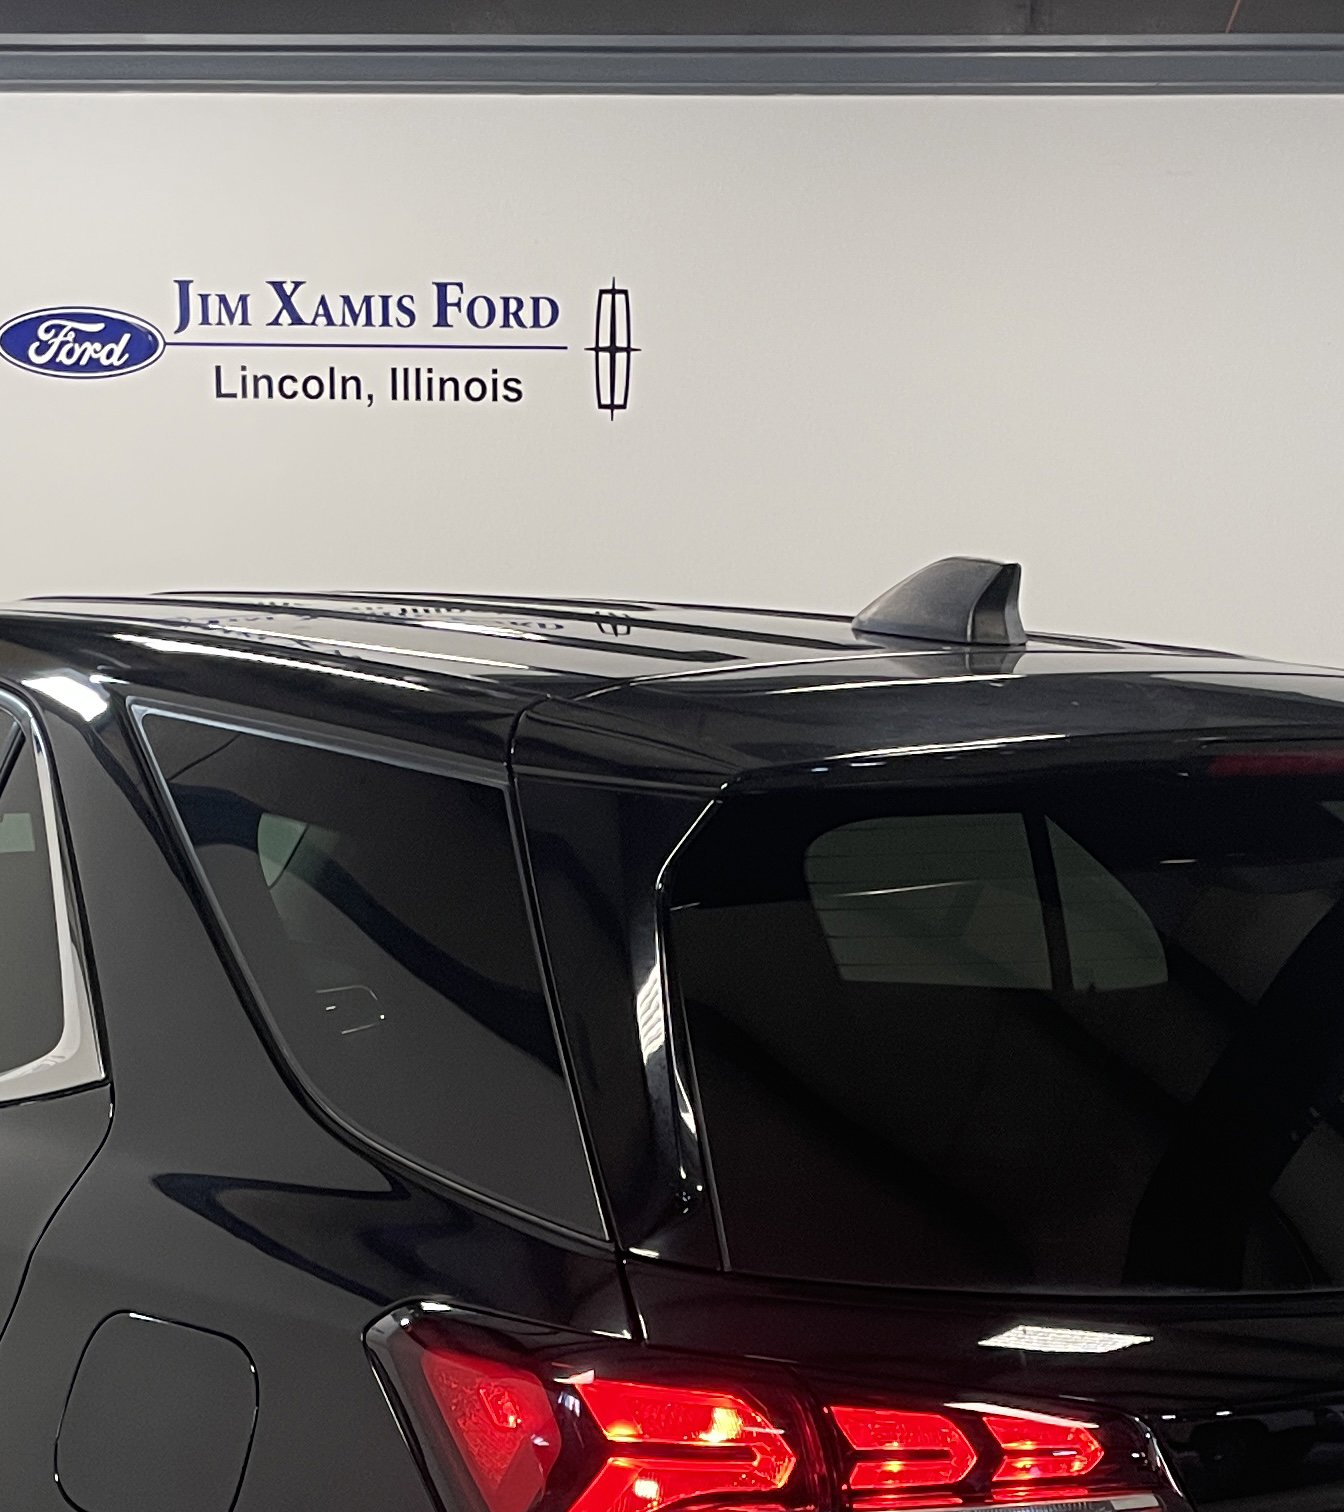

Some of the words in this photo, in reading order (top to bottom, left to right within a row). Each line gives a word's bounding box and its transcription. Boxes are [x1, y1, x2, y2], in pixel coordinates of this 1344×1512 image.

[173, 279, 252, 333] JIM
[265, 281, 416, 329] XAMIS
[431, 281, 560, 329] FORD
[26, 319, 130, 368] Ford
[214, 364, 375, 408] Lincoln,
[389, 366, 523, 403] Illinois
